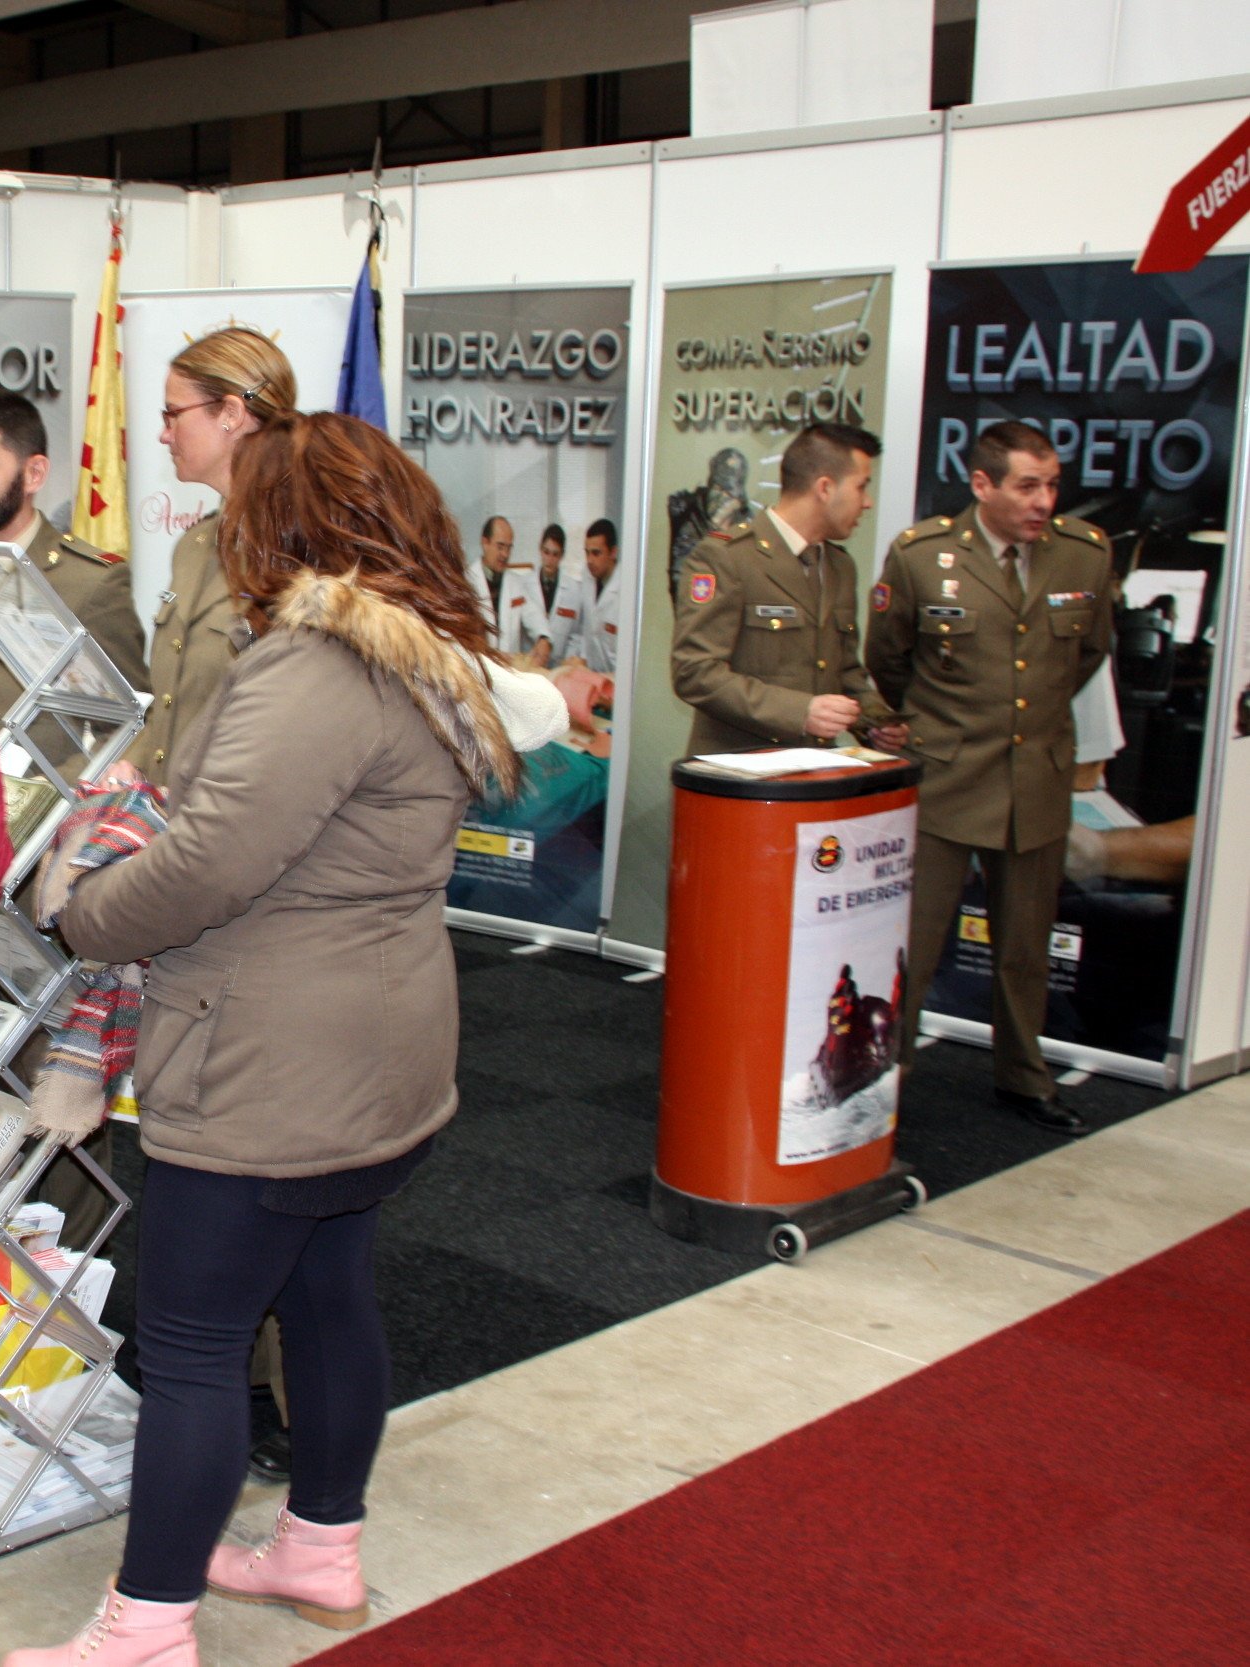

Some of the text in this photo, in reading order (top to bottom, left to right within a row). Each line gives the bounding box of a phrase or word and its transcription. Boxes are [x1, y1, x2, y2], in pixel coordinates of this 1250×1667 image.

[406, 328, 622, 377] LIDERAZGO
[676, 327, 872, 371] COMPAÑERISMO
[946, 319, 1214, 391] LEALTAD
[406, 395, 617, 441] HONRADEZ
[671, 376, 867, 428] SUPERACIÓN
[936, 417, 1212, 489] RPETO
[855, 838, 906, 863] UNIDAD
[817, 894, 842, 913] DE
